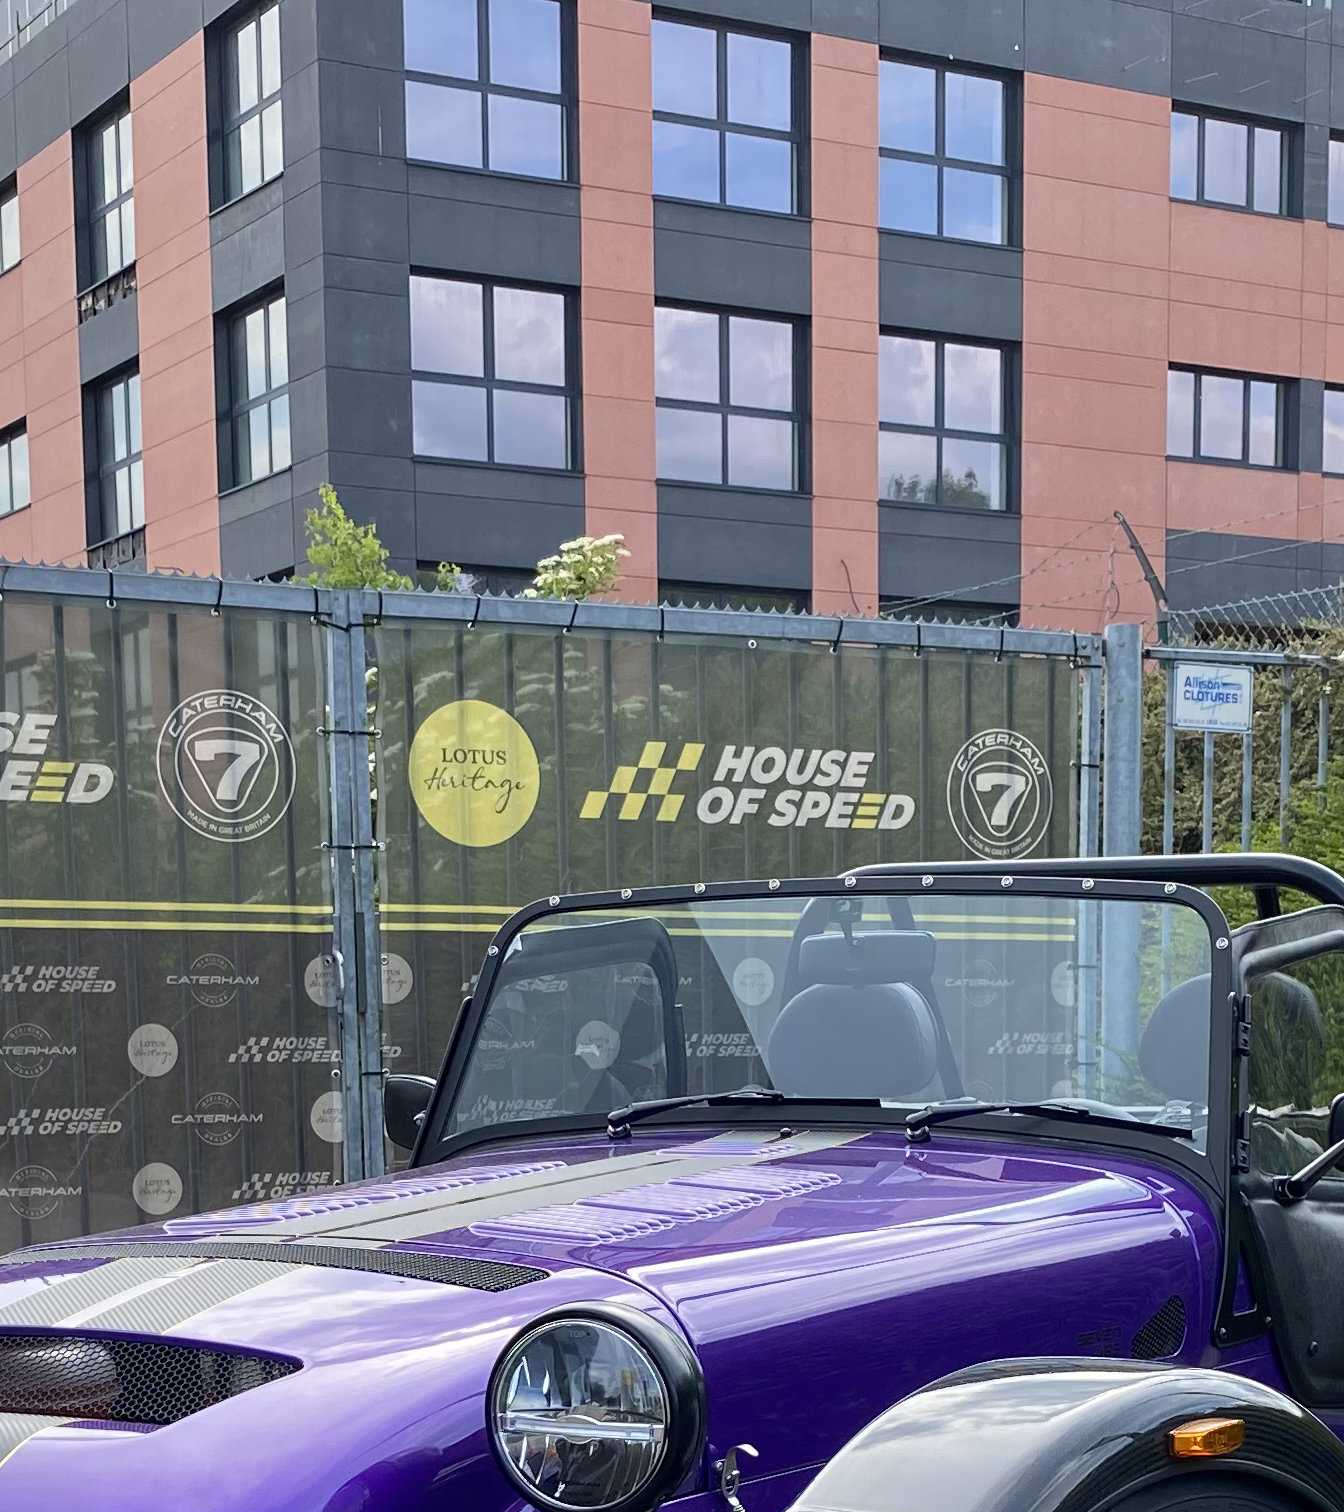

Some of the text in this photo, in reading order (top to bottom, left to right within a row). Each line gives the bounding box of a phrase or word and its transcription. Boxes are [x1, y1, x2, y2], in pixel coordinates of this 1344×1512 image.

[168, 695, 285, 743] CATERHAM
[441, 748, 507, 765] LOTUS
[957, 734, 1045, 775] CATERHAM
[194, 739, 260, 800] 7
[713, 745, 875, 788] HOUSE
[424, 766, 525, 814] Heritage
[976, 773, 1026, 826] 7
[697, 786, 915, 830] OF SPEED
[187, 810, 271, 835] MADE IN GREAT BRITAIN
[38, 966, 100, 979] HOUSE
[32, 980, 117, 993] OF SPEED
[166, 975, 260, 985] CATERHAM
[944, 978, 1015, 987] CATERHAM
[273, 1037, 328, 1050] HOUSE
[479, 1040, 535, 1049] ERHAM
[702, 1033, 750, 1044] HOUSE
[1022, 1033, 1064, 1043] HOUSE
[266, 1051, 291, 1063] OF
[696, 1045, 759, 1057] OF SPEED
[45, 1107, 106, 1121] HOUSE
[171, 1113, 263, 1124] CATERHAM
[38, 1121, 122, 1135] OF SPEED
[275, 1172, 331, 1185] HOUSE
[270, 1186, 293, 1199] OF
